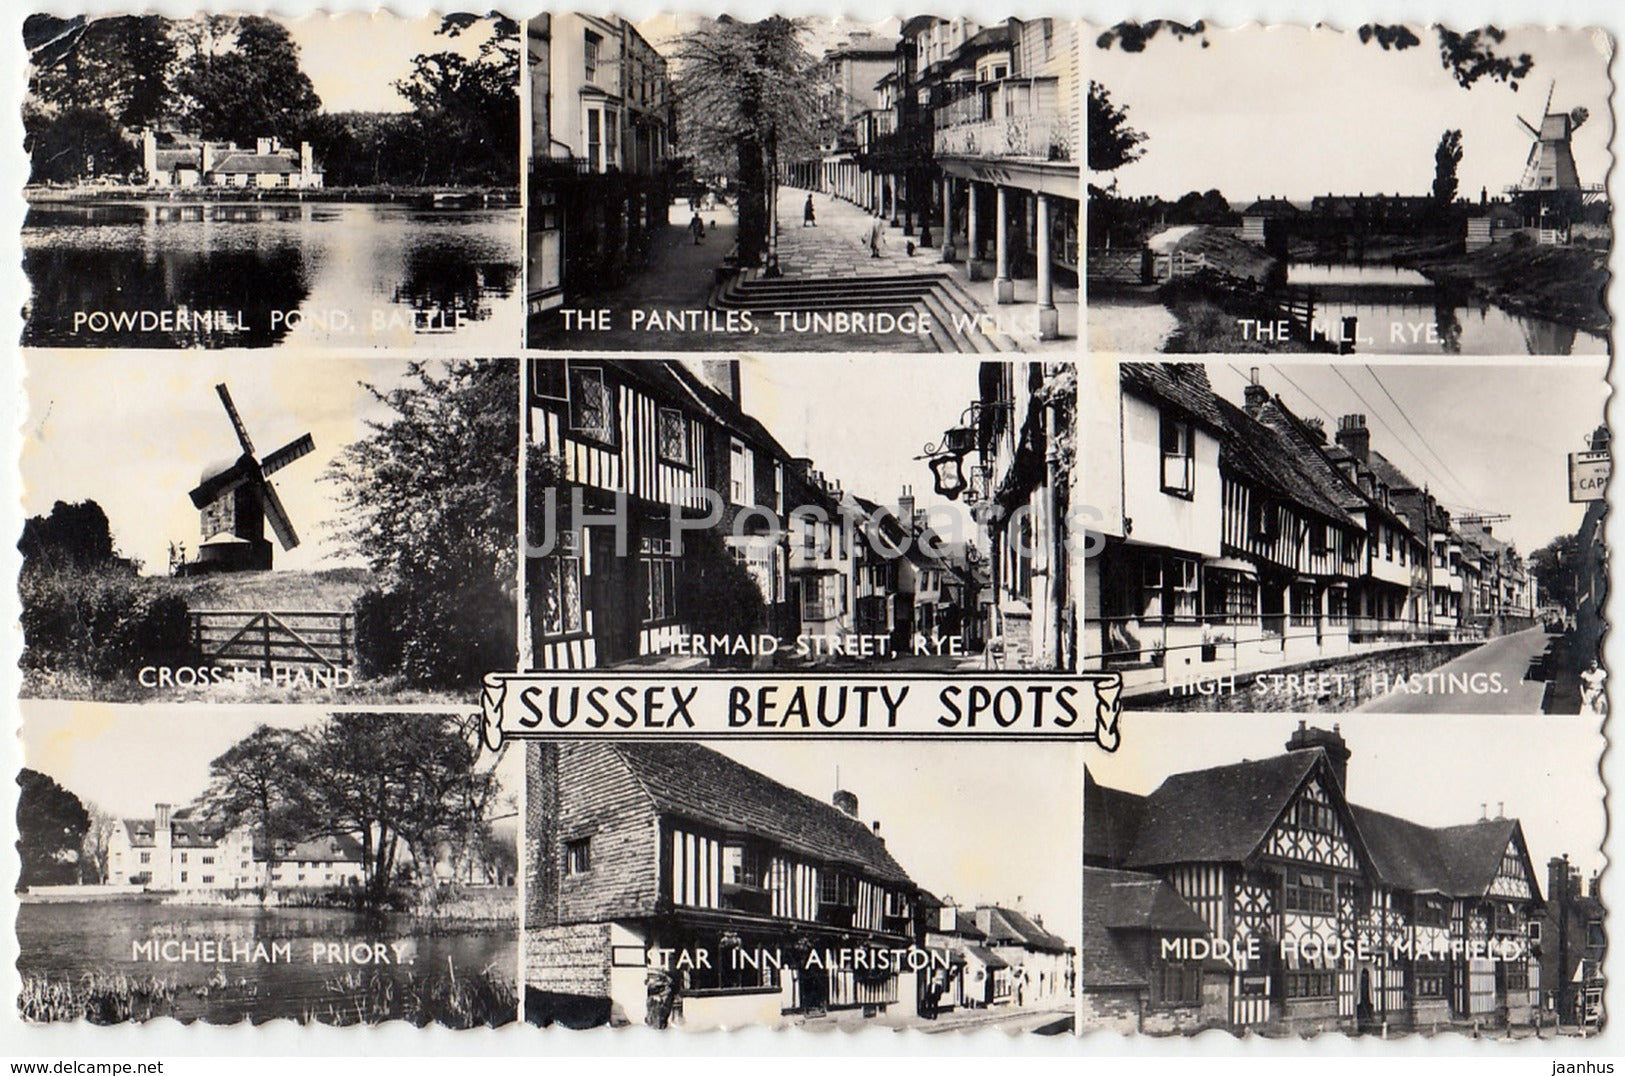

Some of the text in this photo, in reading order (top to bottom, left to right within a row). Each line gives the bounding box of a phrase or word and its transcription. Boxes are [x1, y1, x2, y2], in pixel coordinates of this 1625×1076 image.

[74, 310, 250, 334] POWDERMILL
[560, 309, 611, 332] THE
[631, 310, 759, 335] PANTILES,
[774, 312, 932, 335] TUNBRIDGE
[1237, 319, 1289, 341] THE
[1390, 322, 1445, 345] RYE.
[796, 634, 897, 659] STREET,
[913, 635, 969, 657] RYE.
[1168, 673, 1236, 696] HIGH
[1371, 673, 1509, 695] HASTINGS.
[519, 685, 1079, 729] SUSSEX BEAUTY SPOTS
[132, 940, 415, 965] MICHELHAM PRIORY.
[646, 949, 712, 970] STAR
[1160, 938, 1261, 961] MIDDLE
[1280, 938, 1378, 963] HOUSE,
